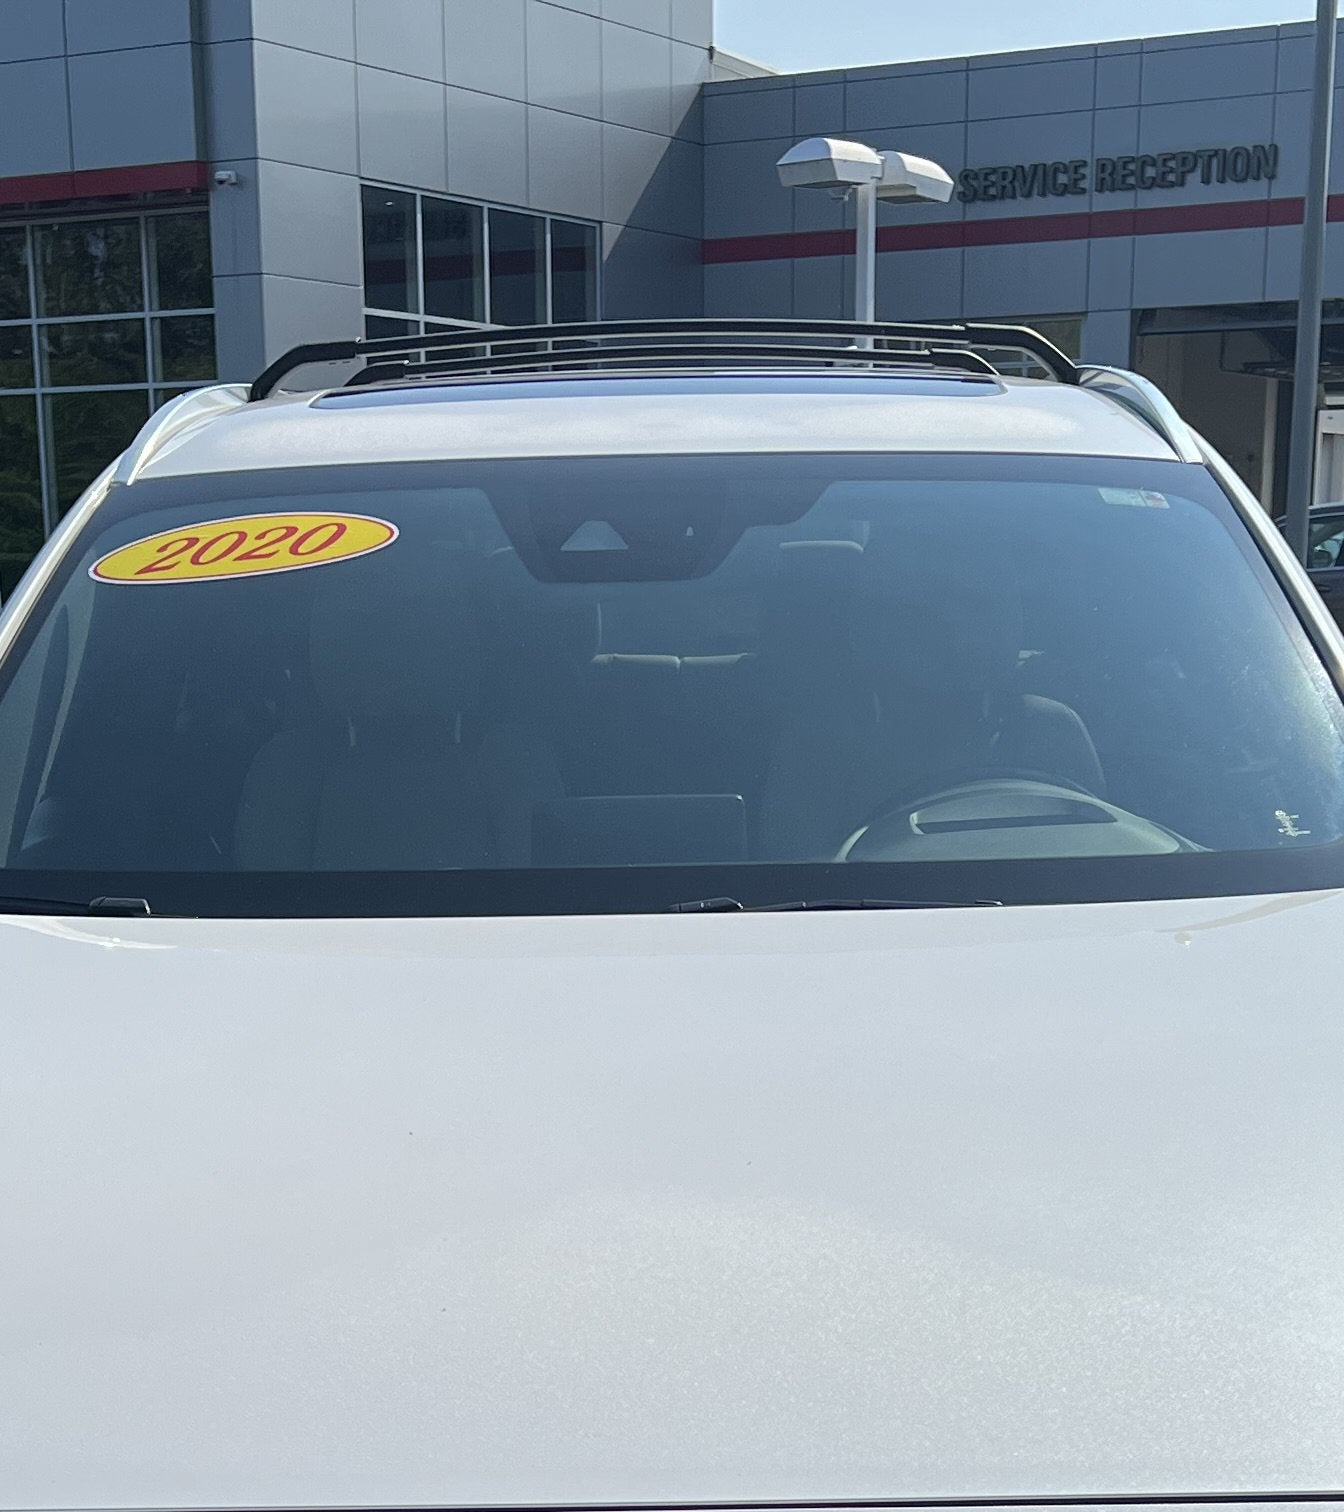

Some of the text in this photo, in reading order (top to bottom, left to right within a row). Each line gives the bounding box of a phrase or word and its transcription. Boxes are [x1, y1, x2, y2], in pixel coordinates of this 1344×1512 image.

[957, 144, 1278, 202] SERVICE RECEPTION
[134, 523, 347, 575] 2020
